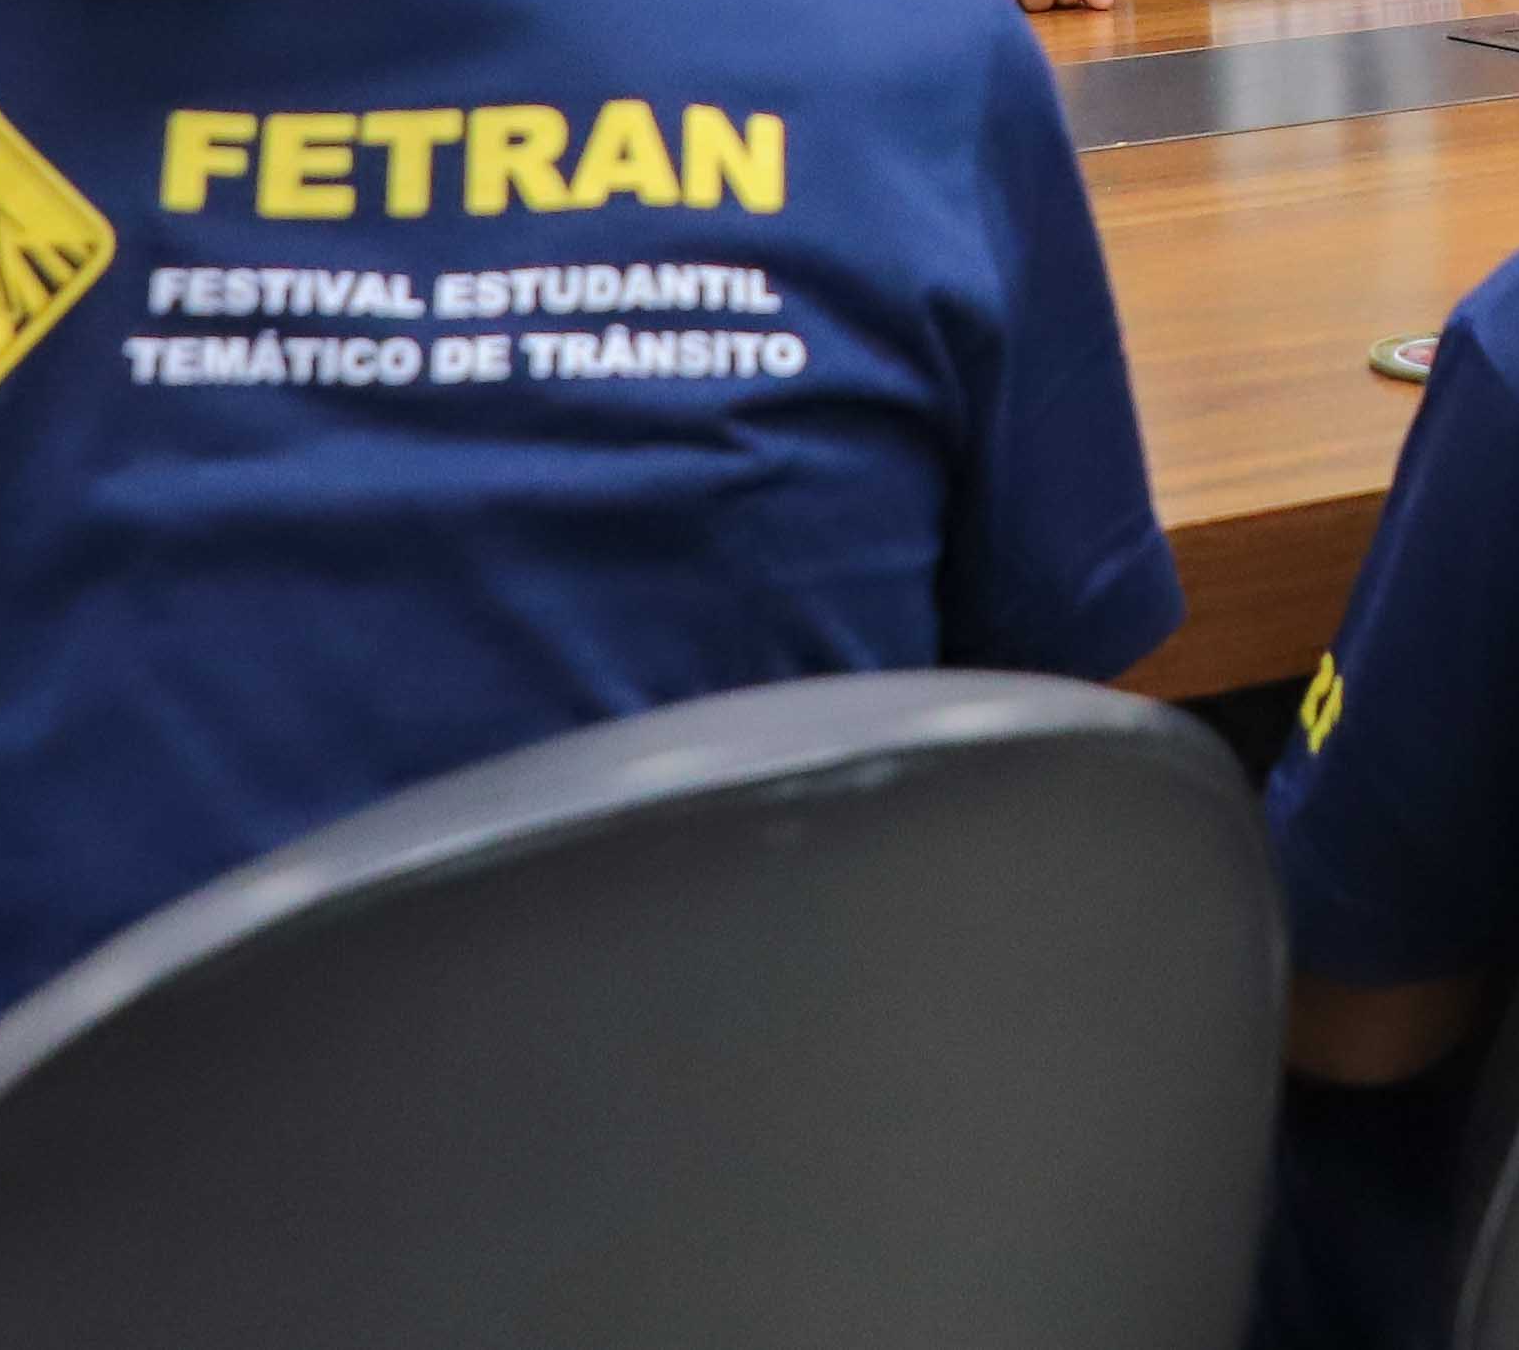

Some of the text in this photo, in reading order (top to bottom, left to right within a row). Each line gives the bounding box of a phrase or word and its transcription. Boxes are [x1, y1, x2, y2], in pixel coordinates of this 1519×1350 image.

[159, 99, 785, 219] FETRAN
[148, 263, 782, 319] FESTIVAL ESTUDANTIL
[122, 324, 808, 386] TEMÁTICO DE TRÂNSITO
